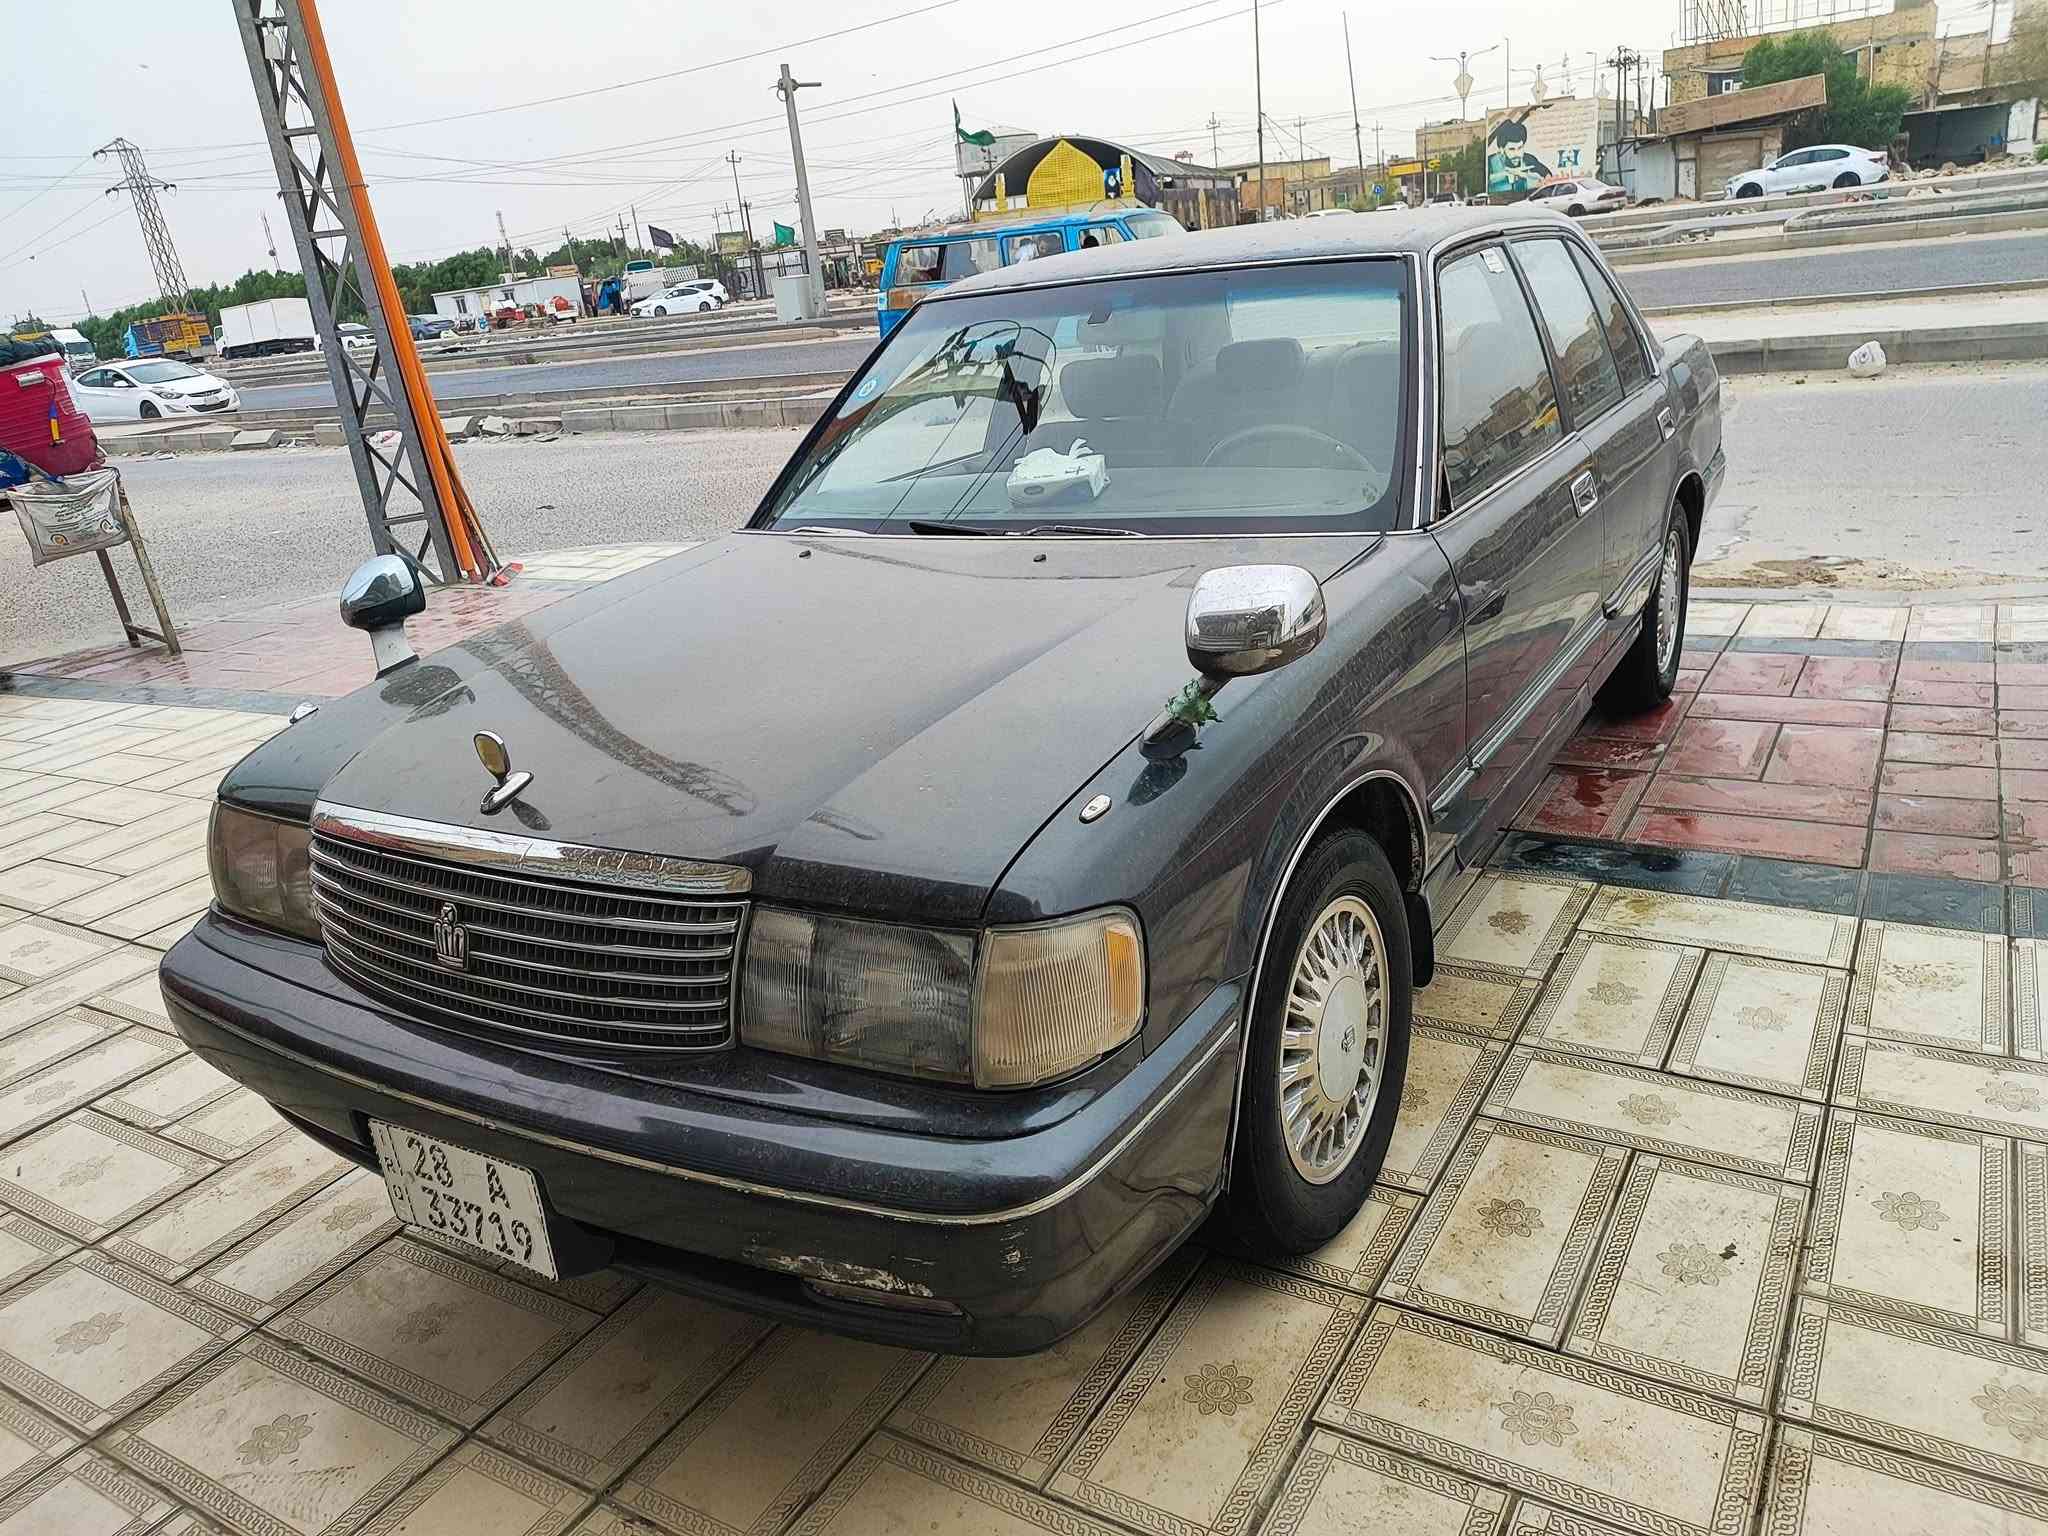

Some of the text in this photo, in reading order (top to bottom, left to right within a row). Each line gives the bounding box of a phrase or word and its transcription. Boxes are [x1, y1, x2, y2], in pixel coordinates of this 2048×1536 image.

[406, 1136, 512, 1210] 28 A
[421, 1185, 533, 1262] 33719
